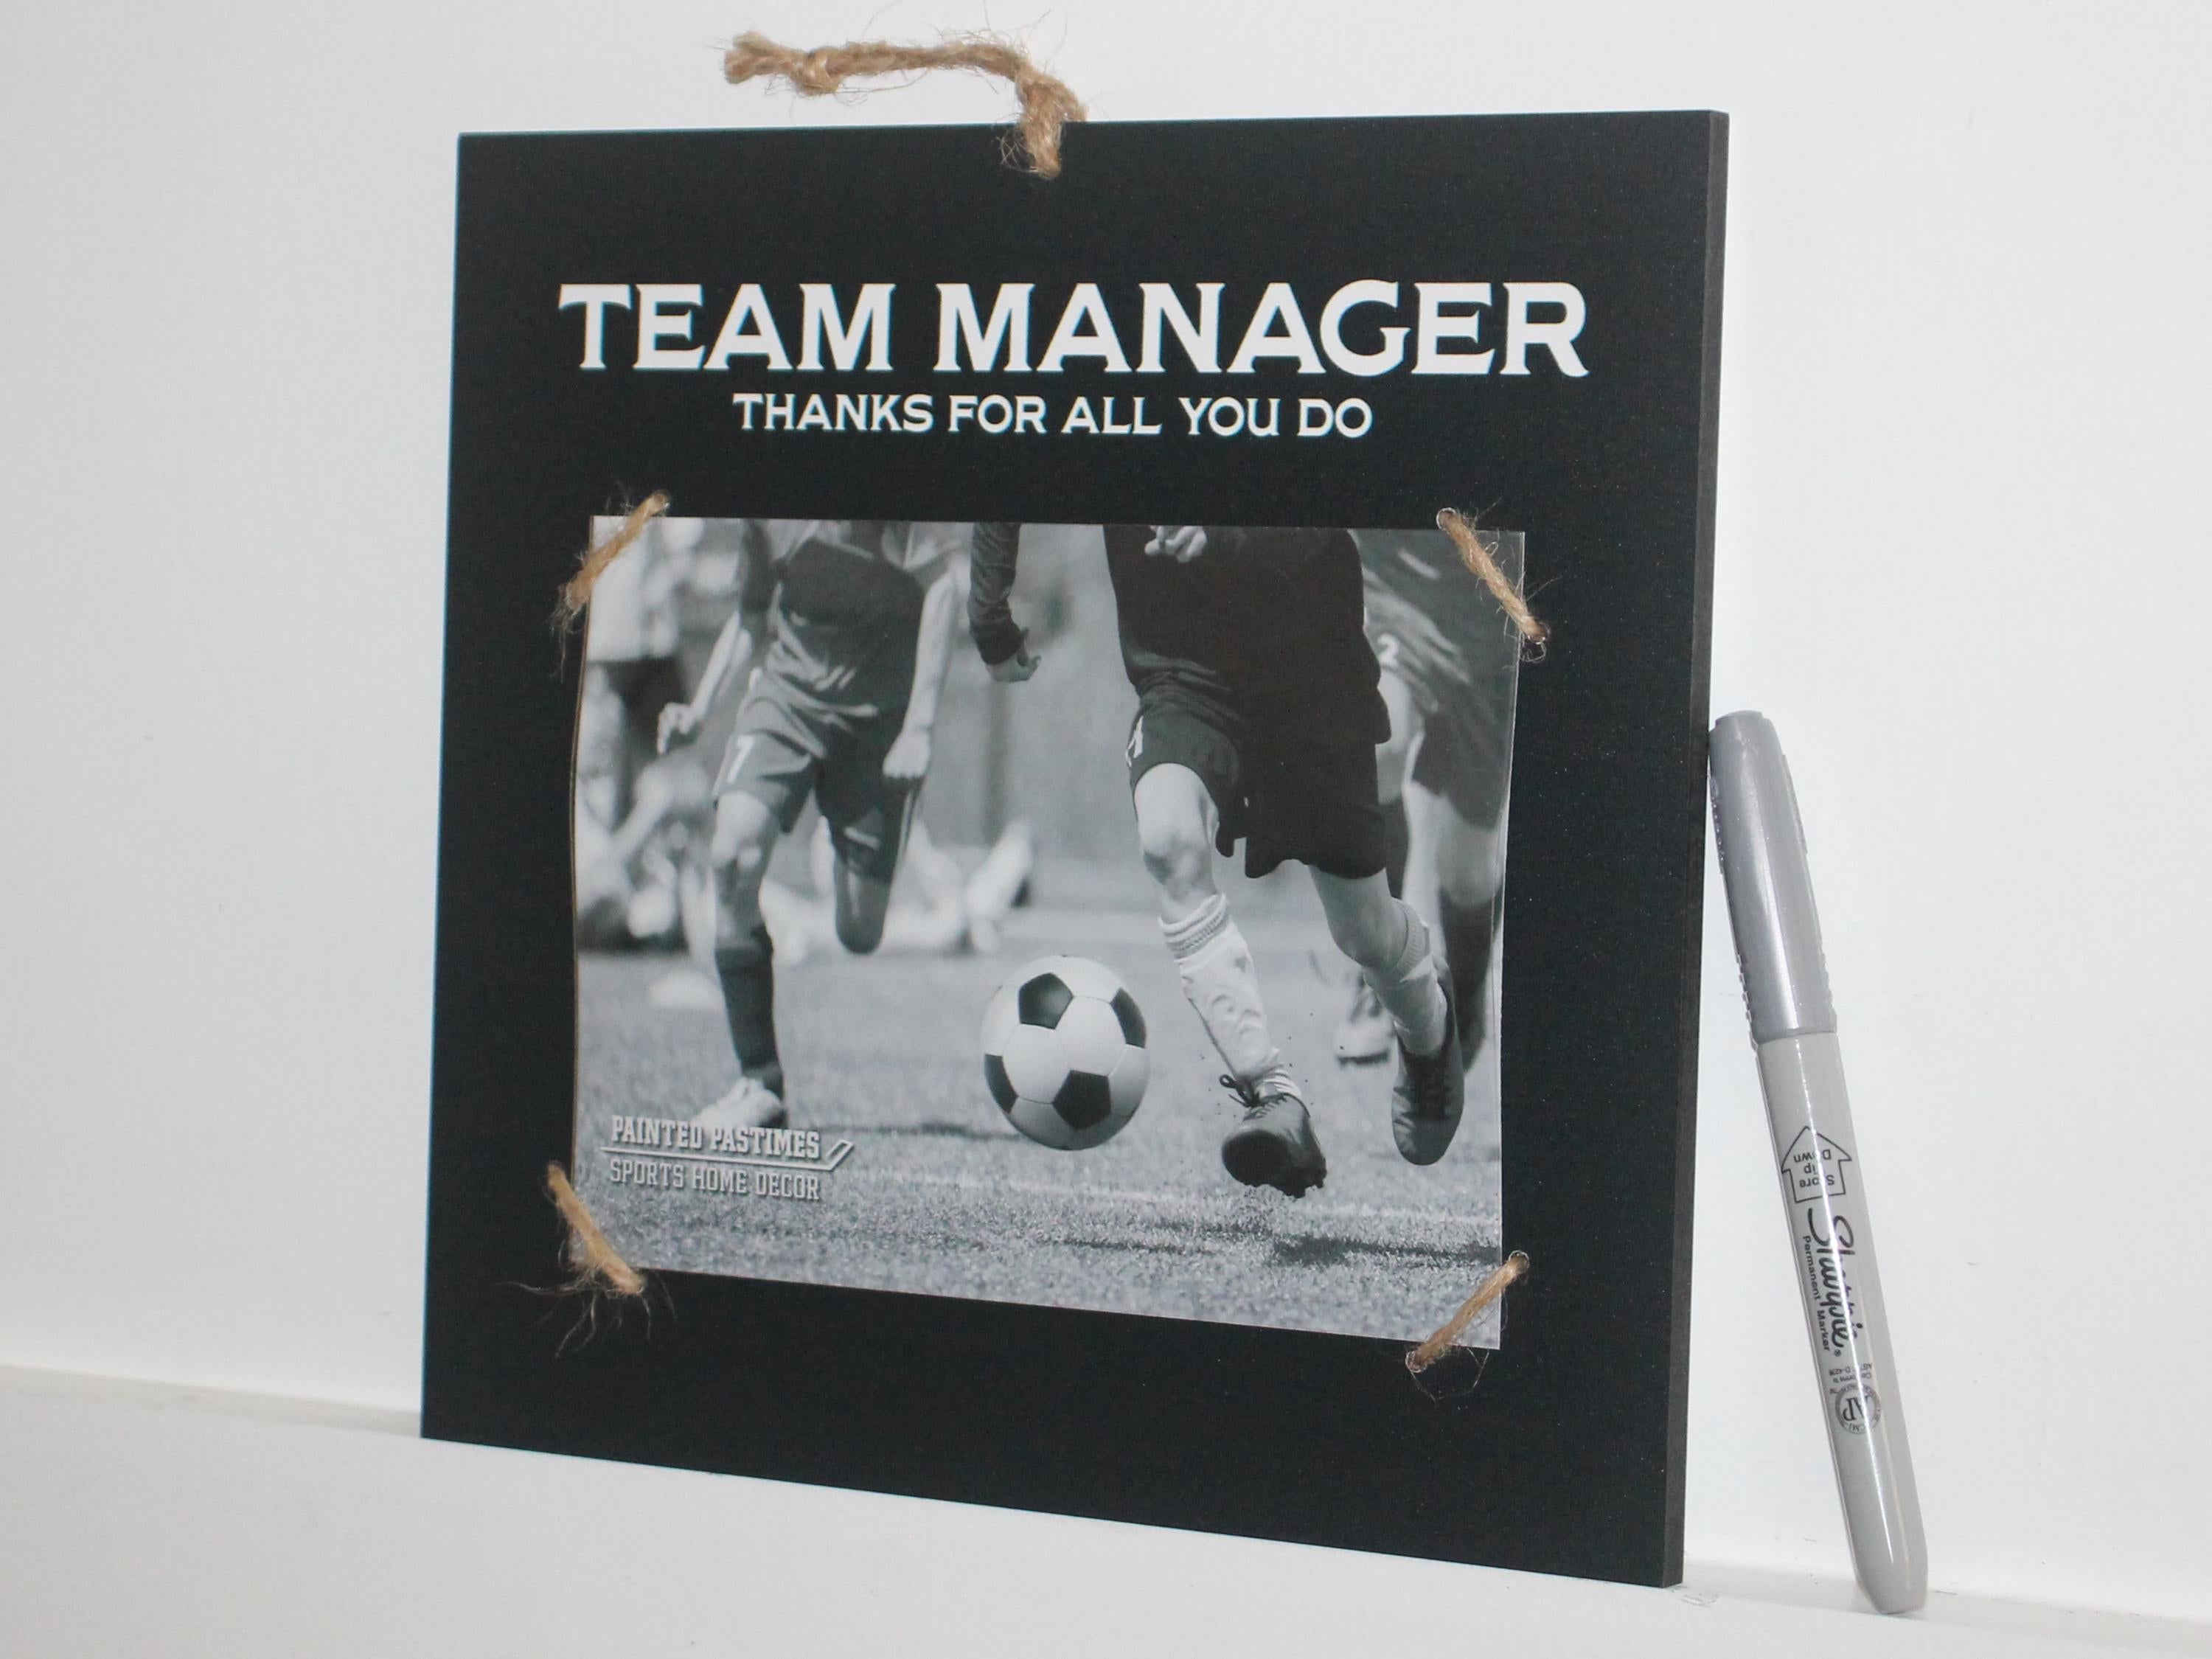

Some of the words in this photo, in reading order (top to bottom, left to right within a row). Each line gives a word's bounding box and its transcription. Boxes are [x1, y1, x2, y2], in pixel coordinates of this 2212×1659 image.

[558, 283, 896, 372] TEAM
[933, 279, 1590, 378] MANAGER
[732, 392, 934, 433] THANKS
[947, 394, 1047, 434] FOR
[1060, 396, 1163, 435] ALL
[1178, 397, 1281, 437] YOU
[1296, 397, 1373, 439] DO
[611, 1114, 703, 1150] PAINTED
[711, 1126, 821, 1159] PASTIMES
[610, 1158, 684, 1189] SPORTS
[692, 1166, 748, 1194] HOME
[756, 1171, 820, 1200] DECOR
[1802, 1235, 1822, 1301] Permanent
[1816, 1310, 1831, 1352] Marker
